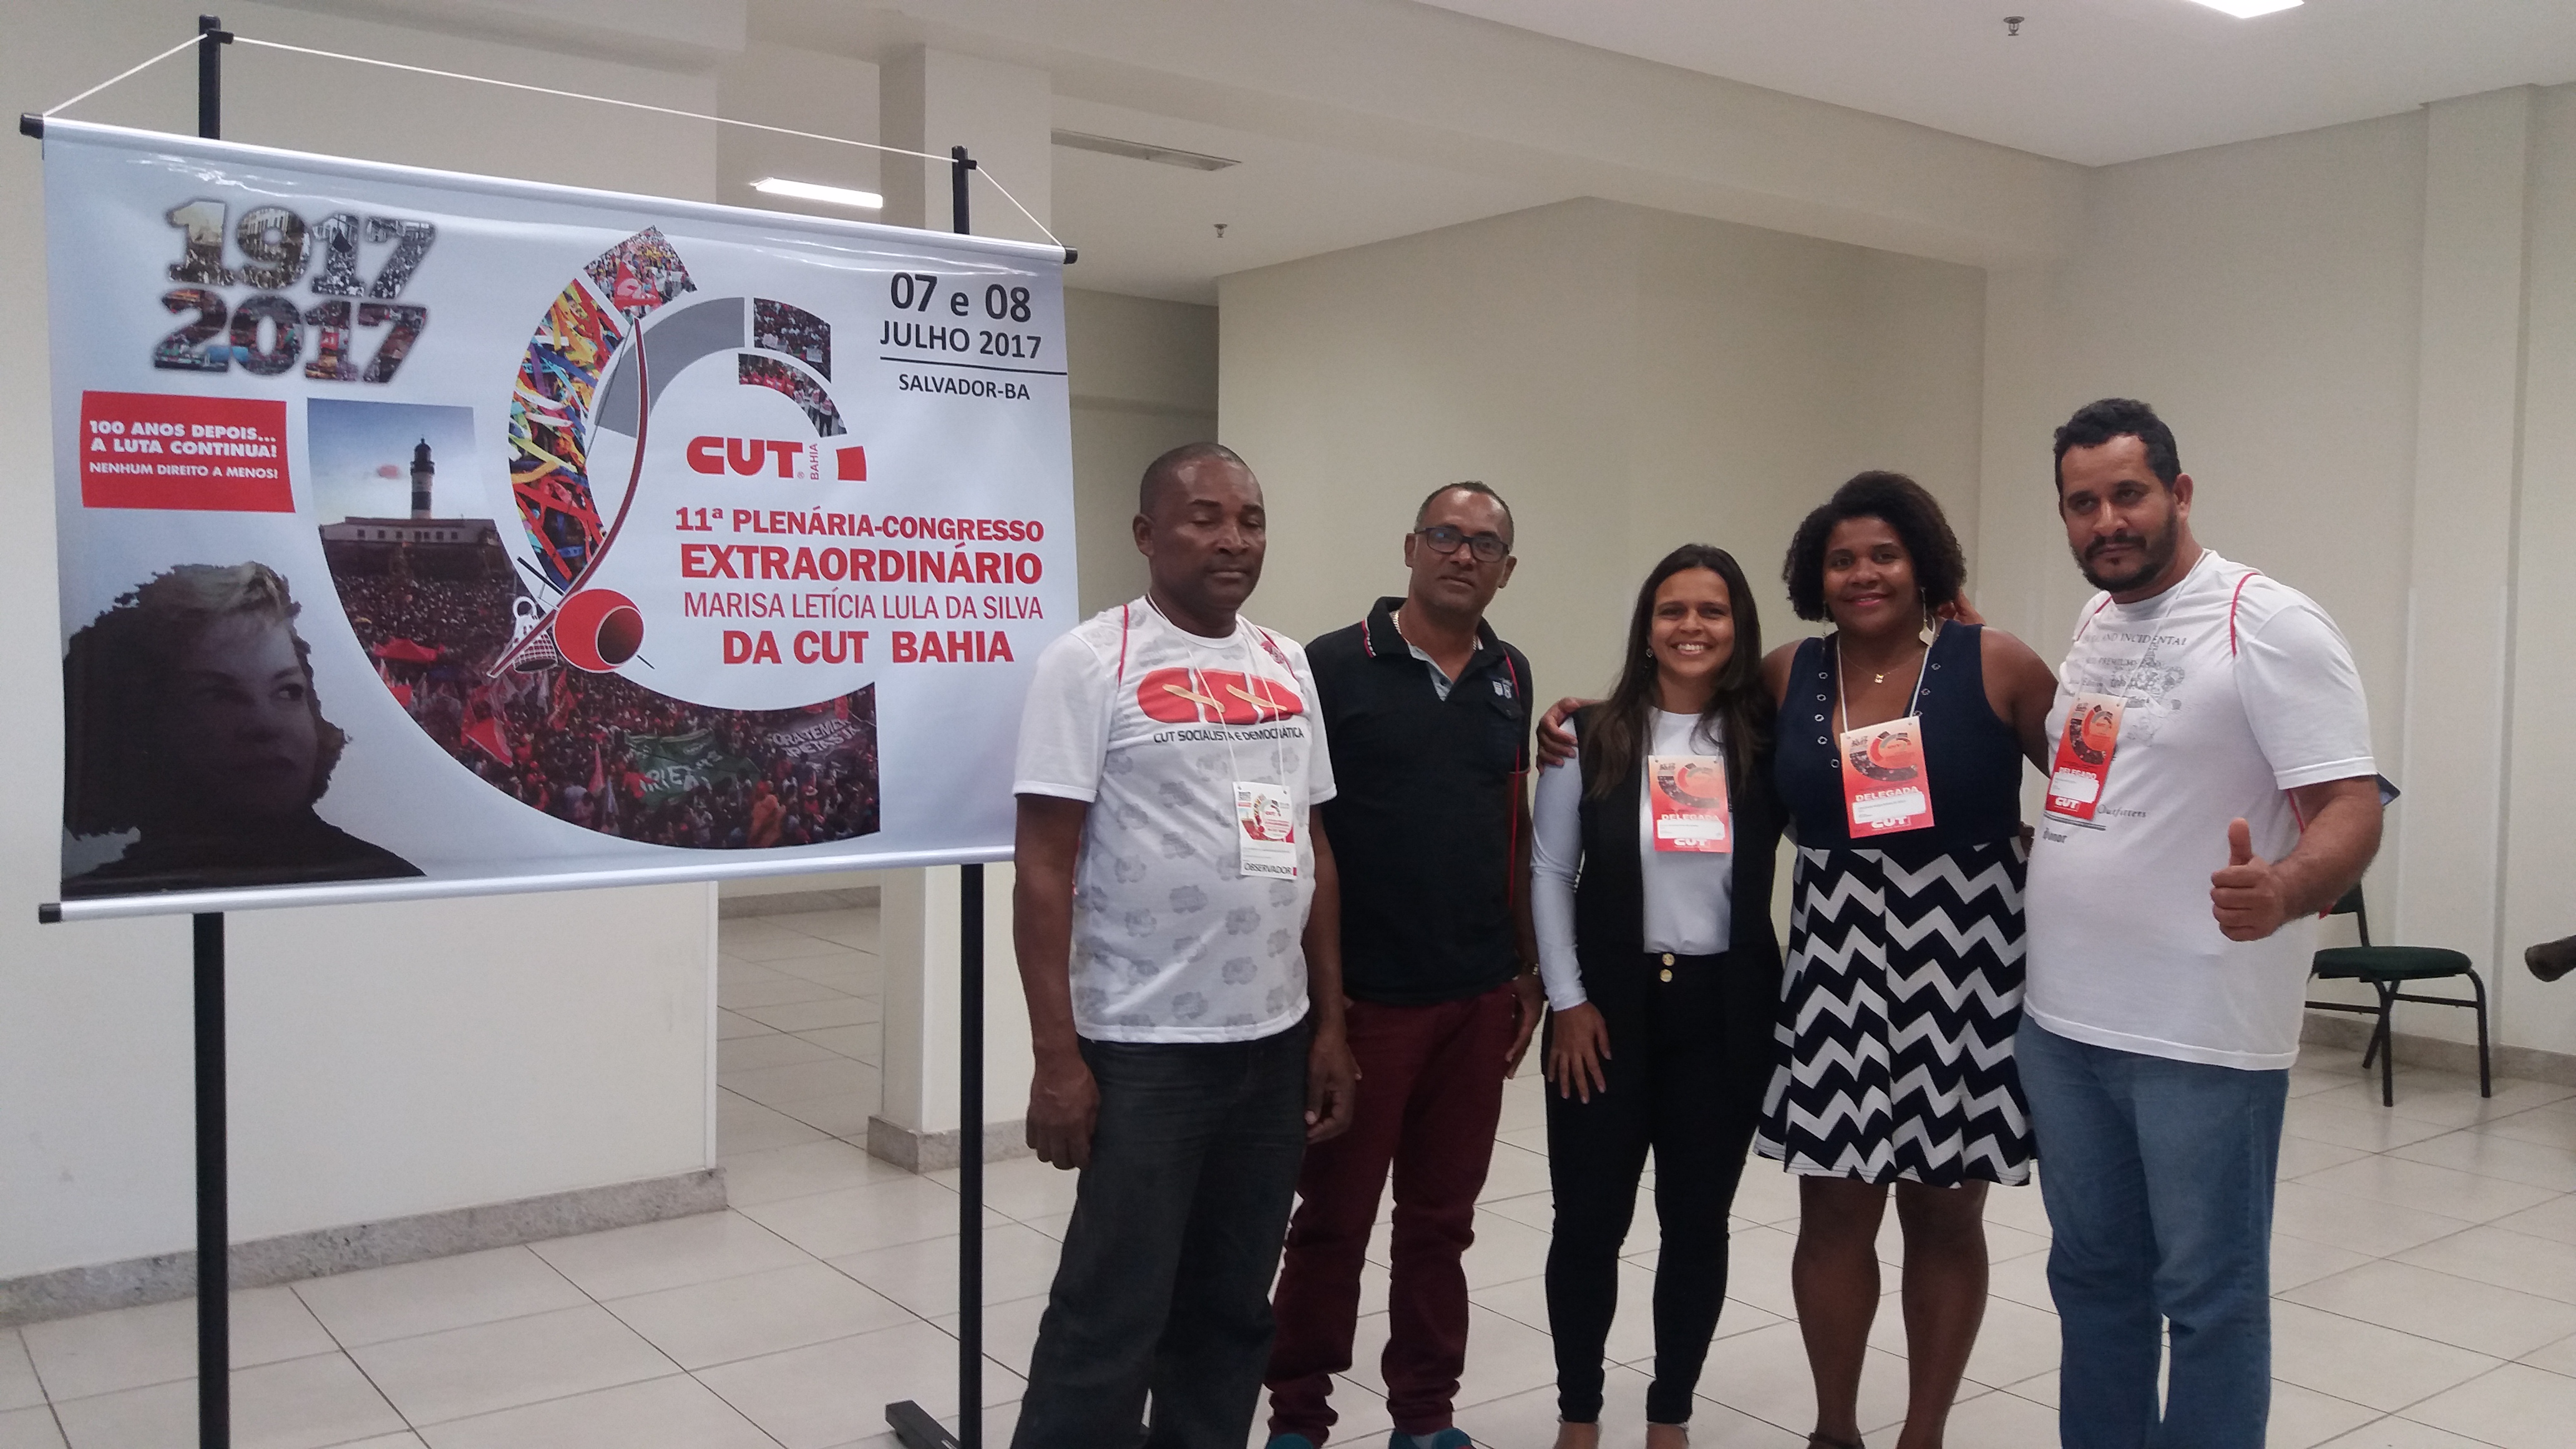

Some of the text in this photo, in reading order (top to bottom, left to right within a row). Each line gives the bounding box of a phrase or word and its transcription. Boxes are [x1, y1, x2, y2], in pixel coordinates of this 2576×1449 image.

[164, 198, 437, 298] 1917
[890, 272, 1032, 323] 07 e 08
[154, 288, 427, 383] 2017
[880, 320, 1042, 359] JULHO 2017
[899, 374, 1030, 400] SALVADOR-BA
[89, 420, 276, 442] 100 ANOS DEPOIS...
[91, 437, 277, 458] A LUTA CONTINUA!
[89, 462, 278, 479] NENHUM DIREITO A MENOS!
[686, 436, 803, 478] CUT
[809, 444, 819, 479] BAHIA
[676, 506, 1043, 542] 11ª PLENÁRIA-CONGRESSO
[681, 542, 1042, 584] EXTRAORDINÁRIO
[685, 587, 1043, 619] MARISA LETÍCIA LULA DA SILVA
[723, 630, 1013, 665] DA CUT BAHIA
[1154, 731, 1175, 743] CUT
[1179, 729, 1236, 741] SOCIALISTA
[1236, 732, 1243, 741] E
[1855, 786, 1919, 802] DELEGADA
[2055, 797, 2079, 809] CUT
[1244, 862, 1292, 875] OBSERVADOR
